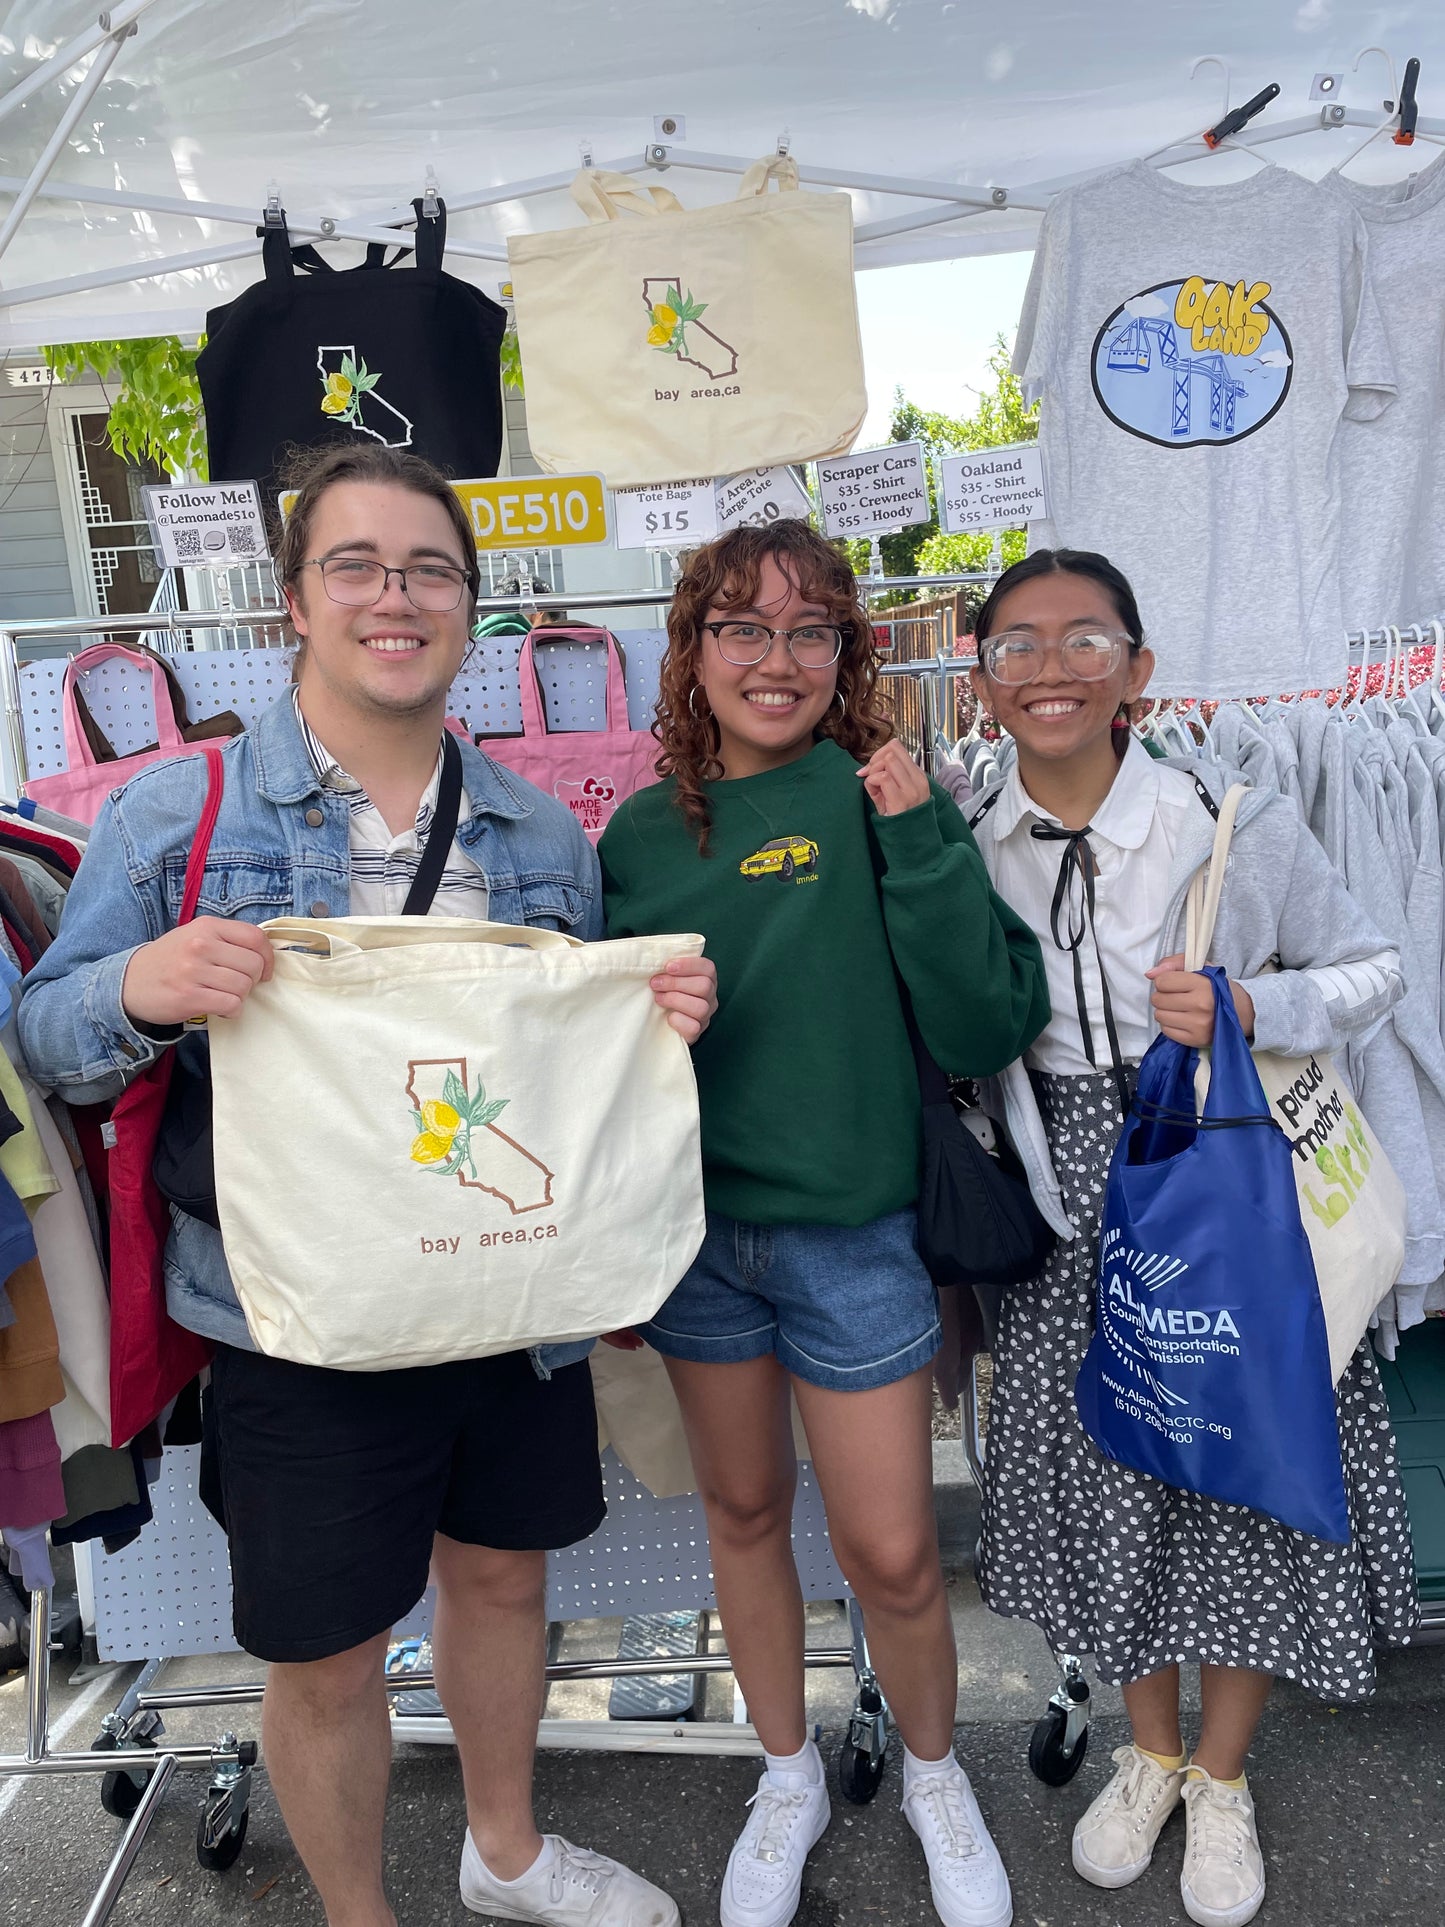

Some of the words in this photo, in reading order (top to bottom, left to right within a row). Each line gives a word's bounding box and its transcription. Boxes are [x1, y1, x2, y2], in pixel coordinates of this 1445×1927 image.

[1174, 275, 1272, 337] OAK
[1190, 315, 1263, 356] LAND
[654, 388, 680, 401] bay
[690, 385, 741, 398] area,ca
[822, 463, 880, 483] Scraper
[883, 457, 917, 472] Cars
[961, 458, 1023, 477] Oakland
[691, 477, 712, 489] Yay
[727, 478, 757, 501] Area,
[838, 484, 861, 498] $35
[872, 476, 906, 490] Shirt
[960, 482, 983, 495] $35
[994, 475, 1026, 489] Shirt
[158, 493, 216, 509] Follow
[220, 489, 253, 505] Me!
[637, 493, 663, 503] Tote
[665, 490, 692, 501] Bags
[719, 497, 749, 520] Large
[746, 479, 773, 499] Tote
[824, 501, 847, 516] $50
[859, 488, 924, 509] Crewneck
[946, 498, 969, 511] $50
[980, 487, 1044, 506] Crewneck
[470, 490, 589, 537] DE510
[645, 510, 690, 534] $15
[838, 515, 861, 529] $55
[872, 506, 914, 522] Hoody
[959, 511, 981, 524] $55
[992, 504, 1033, 519] Hoody
[569, 799, 601, 810] MADE
[584, 808, 603, 817] THE
[581, 818, 600, 829] AY
[1276, 1055, 1324, 1129] proud
[1294, 1089, 1344, 1162] mother
[420, 1236, 461, 1255] bay
[479, 1224, 559, 1247] area,ca
[1108, 1273, 1241, 1338] ALMEDA
[1114, 1397, 1141, 1420] (510)
